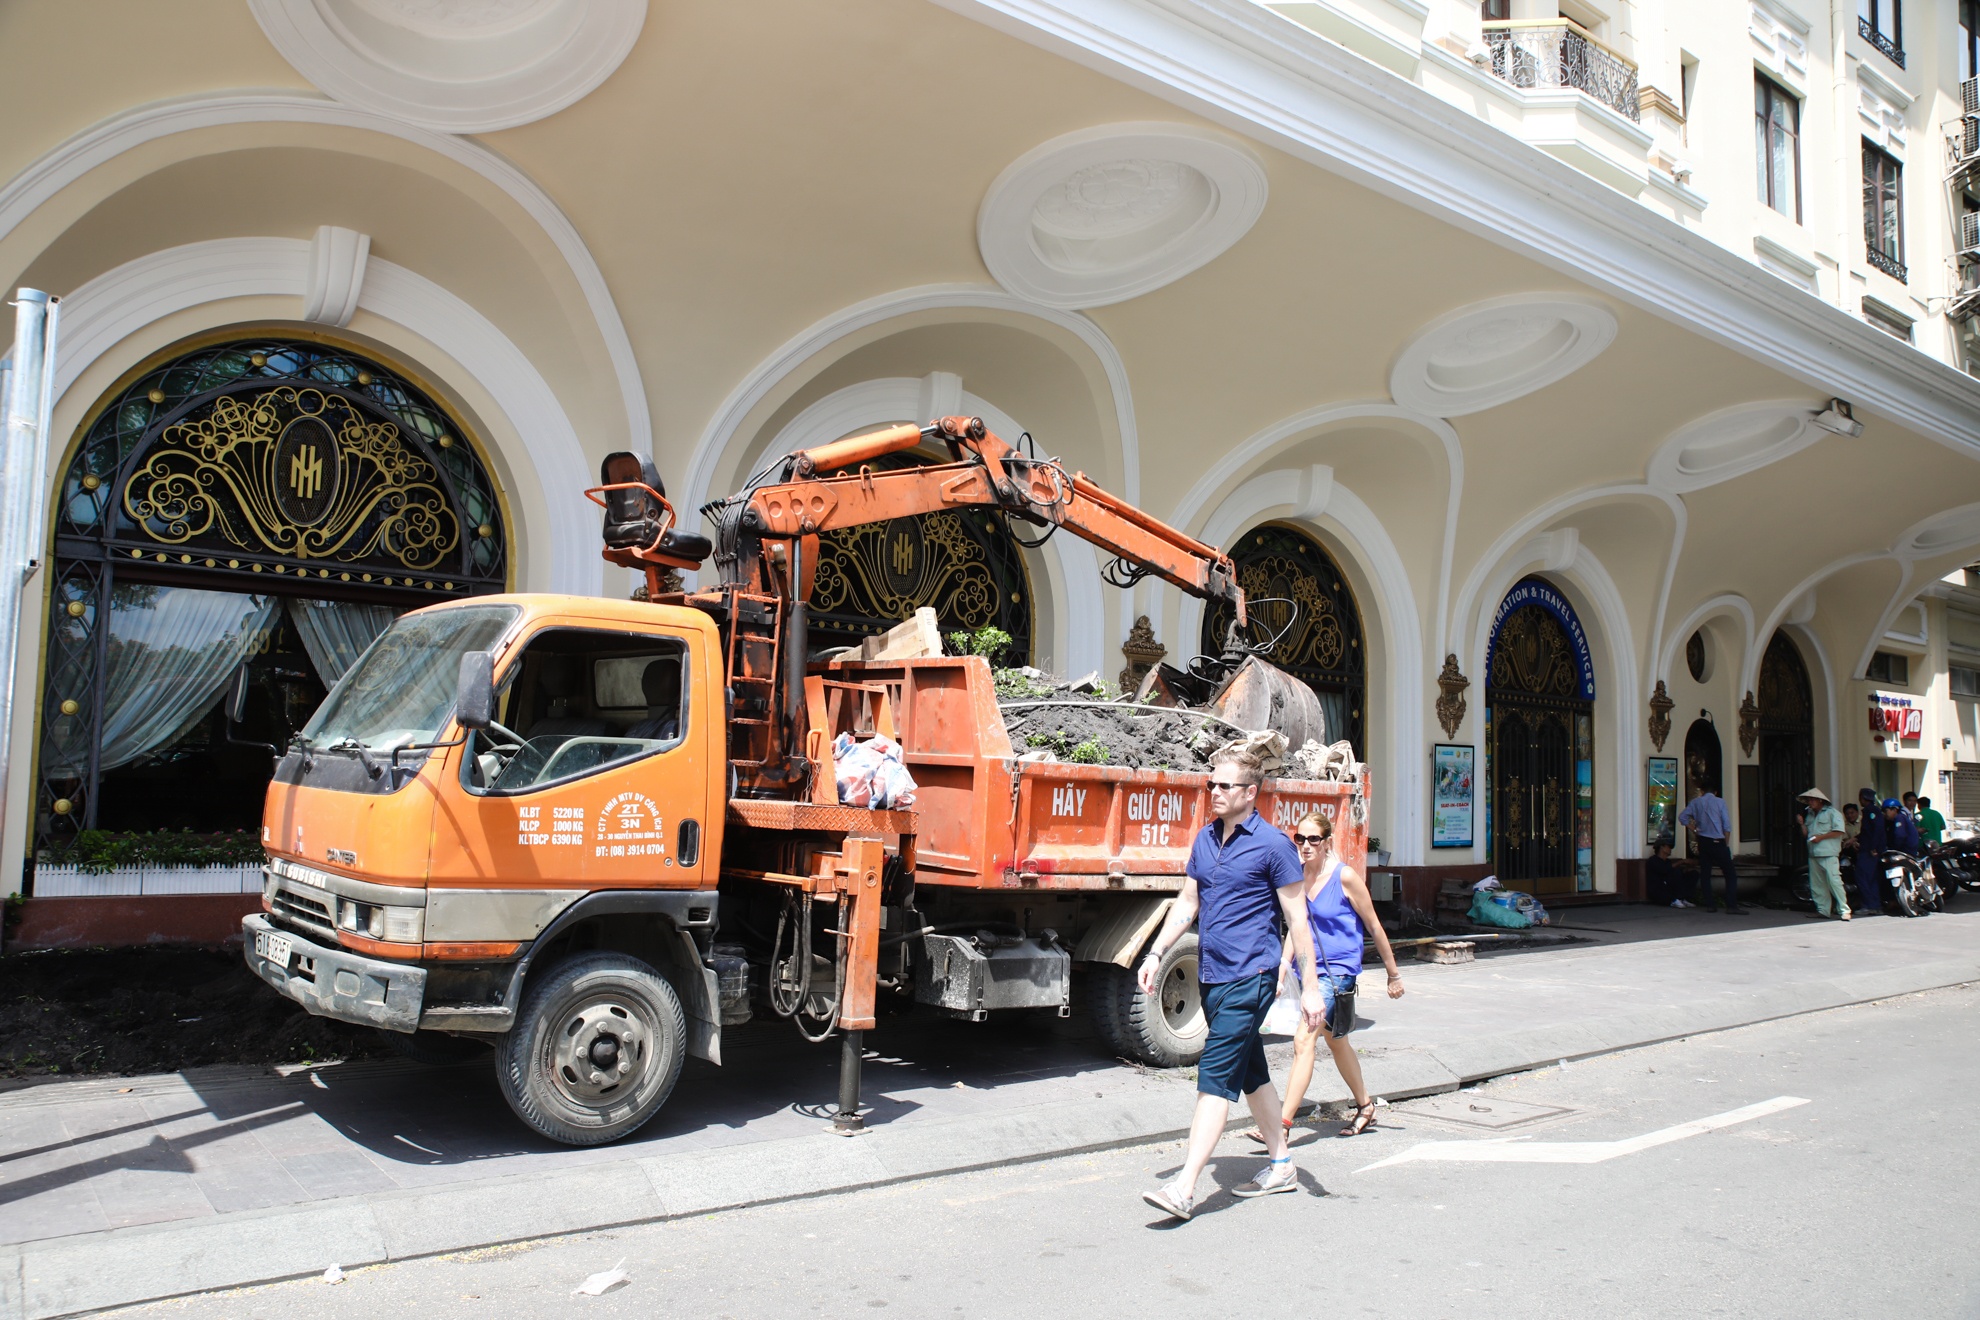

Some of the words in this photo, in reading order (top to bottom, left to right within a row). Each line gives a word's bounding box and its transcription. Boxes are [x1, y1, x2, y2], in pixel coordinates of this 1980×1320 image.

[1530, 586, 1538, 598] &
[1540, 588, 1570, 621] TRAVEL
[1570, 620, 1592, 680] SERVICE
[617, 792, 633, 802] MTV
[1052, 782, 1087, 816] HÃY
[519, 806, 541, 818] KLBT
[553, 807, 573, 818] 5220
[573, 807, 584, 819] KG
[601, 797, 618, 816] TNHH
[621, 803, 640, 814] 2T
[1158, 789, 1183, 821] GÌN
[519, 820, 540, 832] KLCP
[553, 820, 572, 832] 1000
[573, 820, 584, 832] KG
[598, 816, 607, 832] CTY
[620, 818, 640, 829] 3N
[518, 833, 549, 845] KLTBCP
[551, 834, 571, 845] 6390
[572, 834, 583, 845] KG
[1141, 823, 1170, 845] 51C
[610, 845, 625, 857] (08)
[627, 844, 645, 855] 3914
[646, 843, 665, 855] 0704
[273, 860, 327, 889] MITSUBISHI
